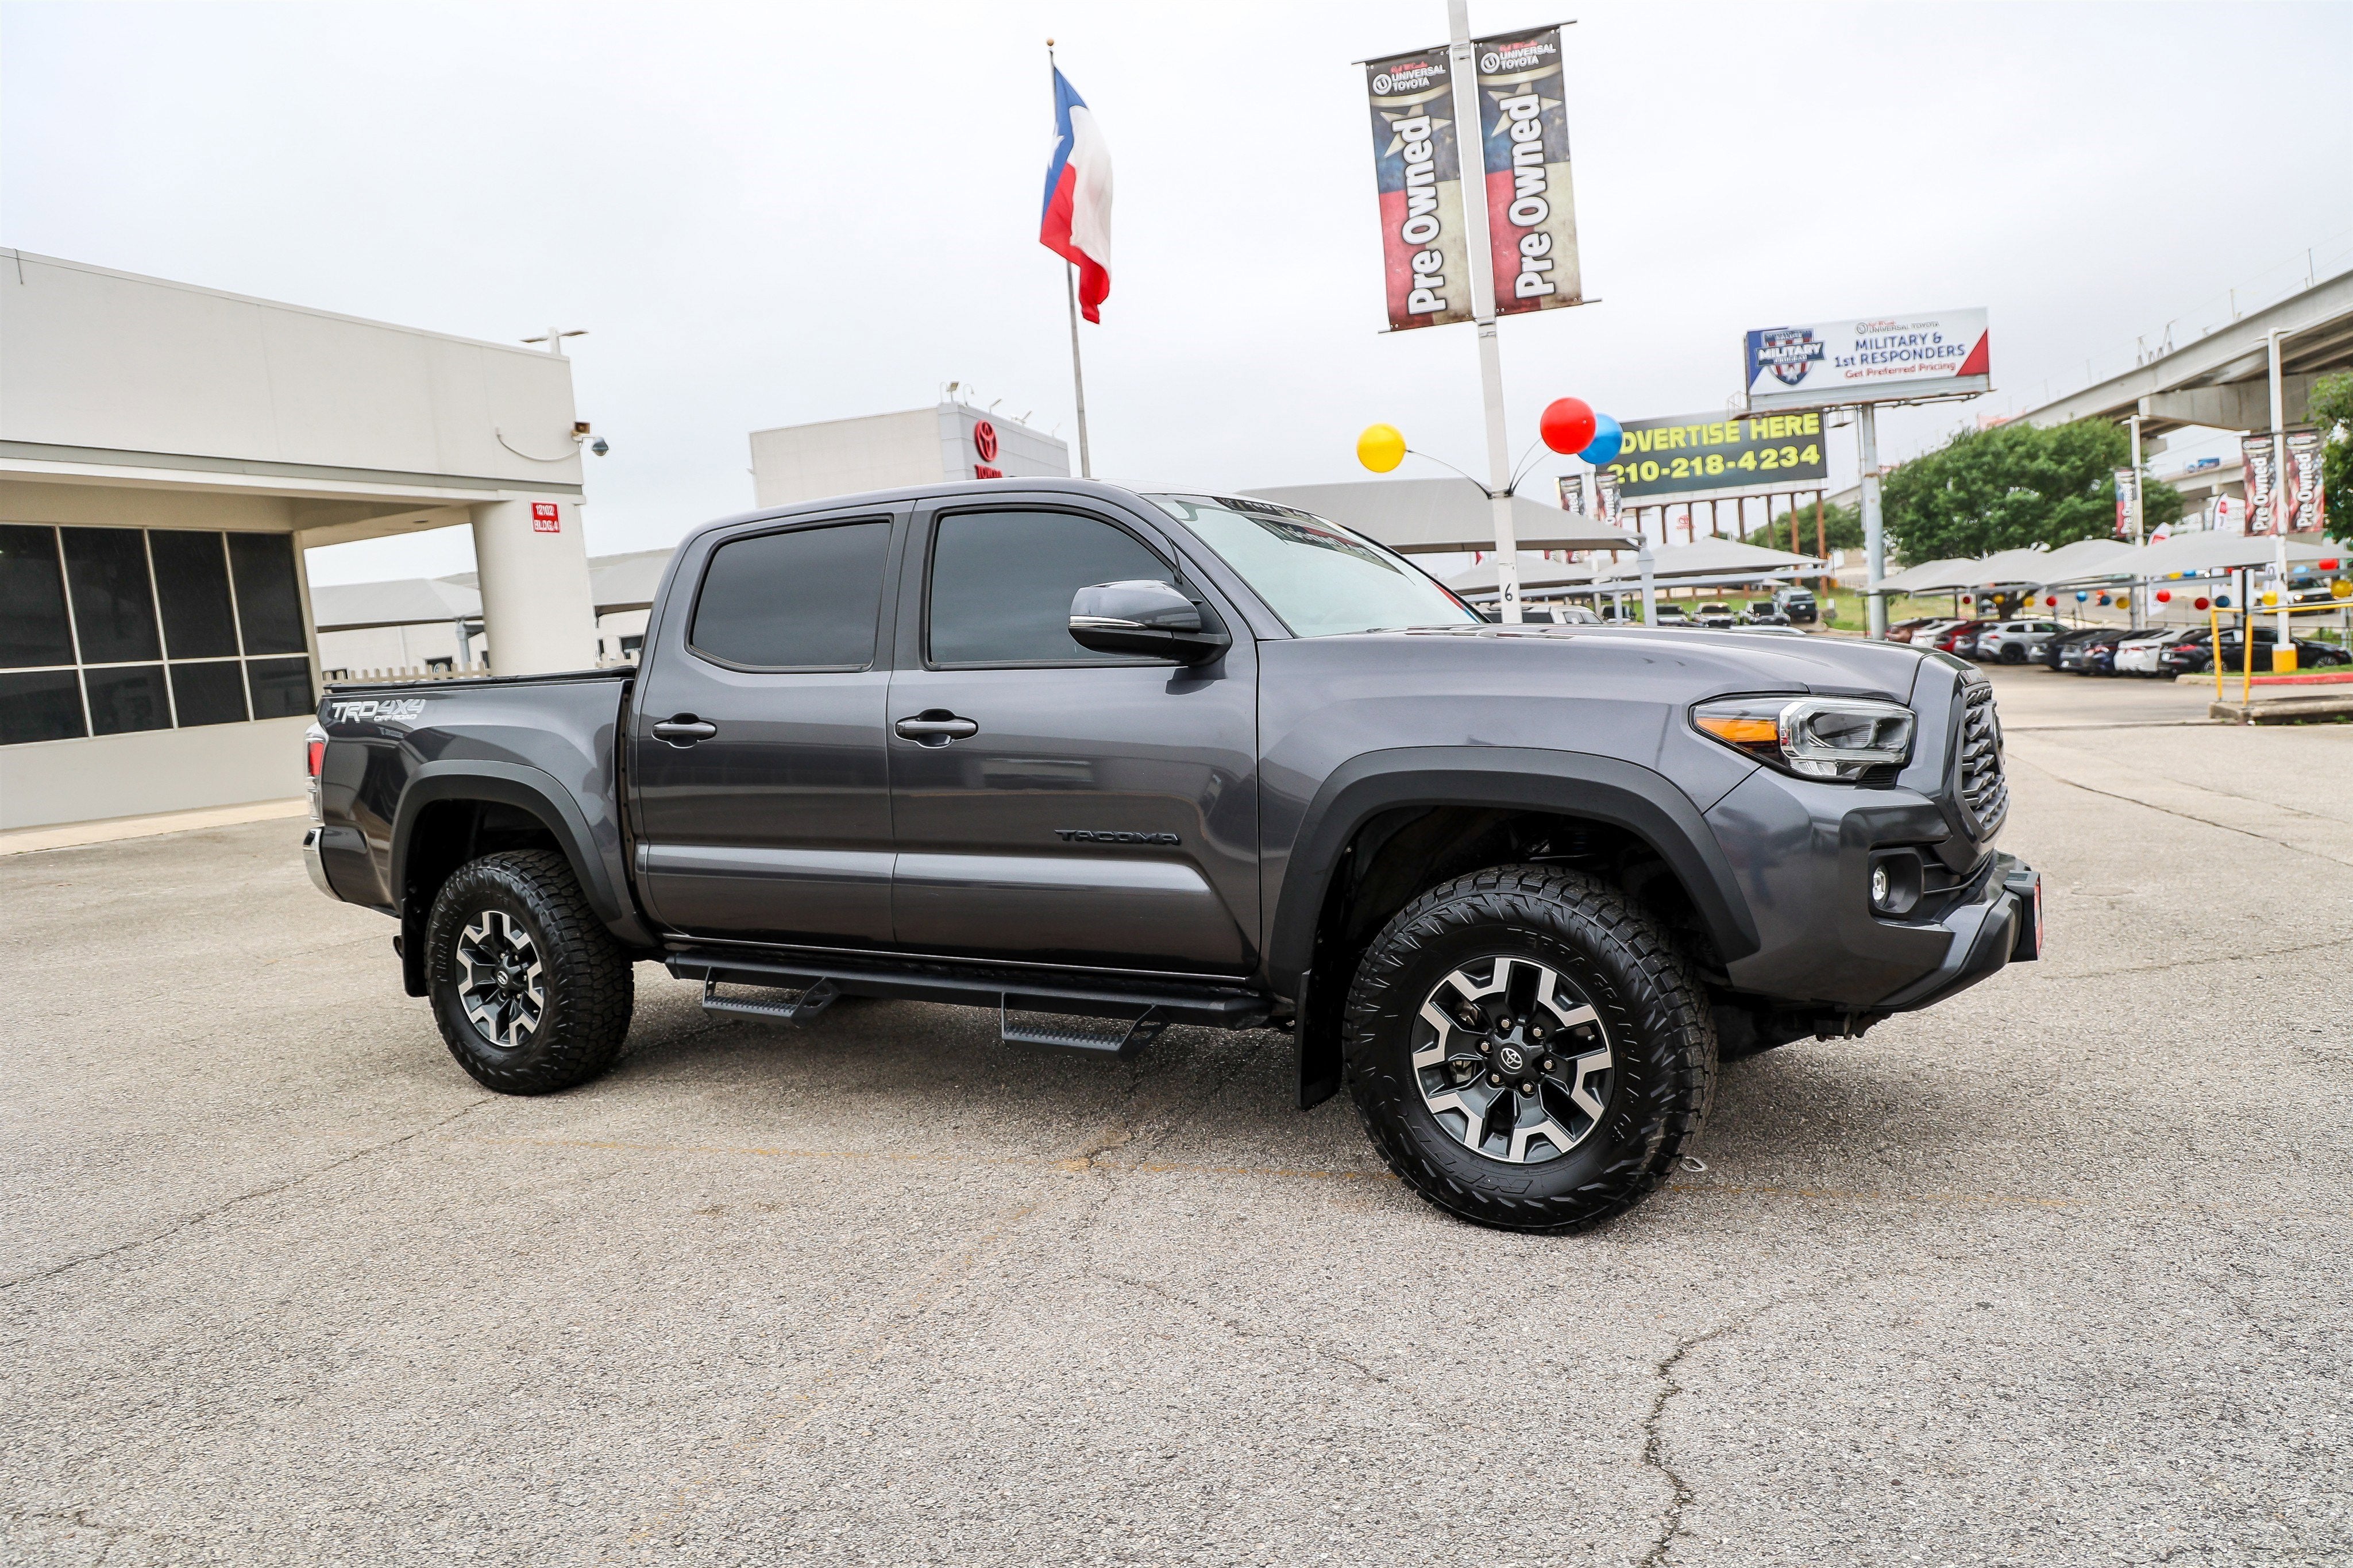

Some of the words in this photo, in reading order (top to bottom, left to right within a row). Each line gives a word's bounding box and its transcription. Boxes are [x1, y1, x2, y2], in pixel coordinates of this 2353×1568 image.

[1499, 44, 1556, 60] UNIVERSAL
[1500, 55, 1540, 70] TOYOTA
[1391, 64, 1446, 81] UNIVERSAL
[1392, 77, 1430, 92] TOYOTA
[1499, 94, 1549, 226] Owned
[1392, 115, 1440, 245] Owned
[1515, 233, 1556, 299] Pre
[1407, 250, 1446, 315] Pre
[1758, 343, 1822, 360] MILITARY
[1856, 332, 1928, 351] MILITARY
[1933, 331, 1943, 343] &
[1835, 356, 1856, 368] 1st
[1861, 343, 1966, 365] RESPONDERS
[1846, 369, 1864, 378] Get
[1867, 364, 1916, 376] Preferred
[1919, 362, 1956, 371] Pricing
[1619, 422, 1741, 454] DVERTISE
[1749, 413, 1820, 440] HERE
[1606, 444, 1820, 484] 210-218-4234
[2250, 457, 2269, 506] Owned
[2294, 453, 2313, 502] Owned
[1505, 582, 1512, 601] 6
[331, 700, 379, 723] TRD
[1054, 829, 1182, 845] TACOMA
